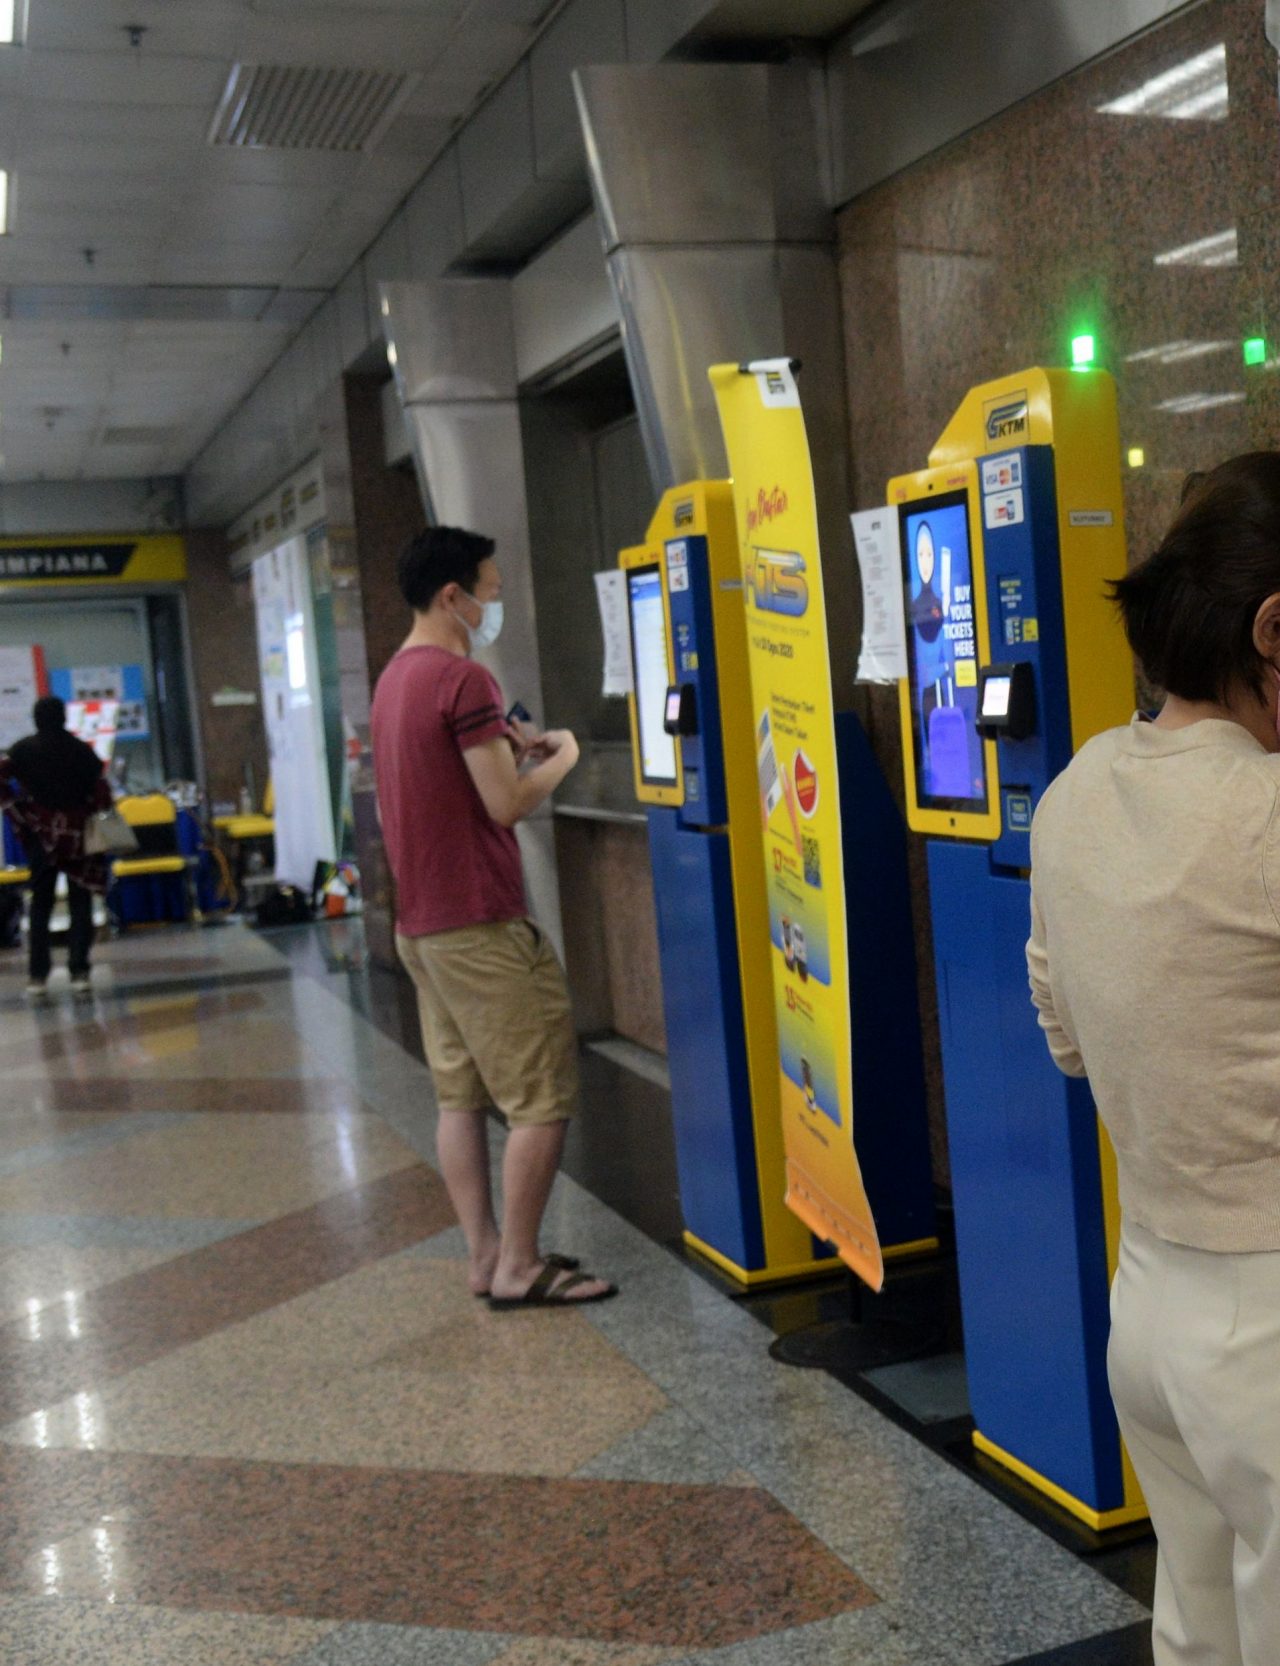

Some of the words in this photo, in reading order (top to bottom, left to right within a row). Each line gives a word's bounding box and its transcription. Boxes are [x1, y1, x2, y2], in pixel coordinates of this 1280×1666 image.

[999, 418, 1024, 437] KTM
[954, 585, 971, 602] BUY
[950, 603, 972, 621] YOUR
[943, 621, 974, 640] TICKETS
[954, 640, 975, 657] HERE
